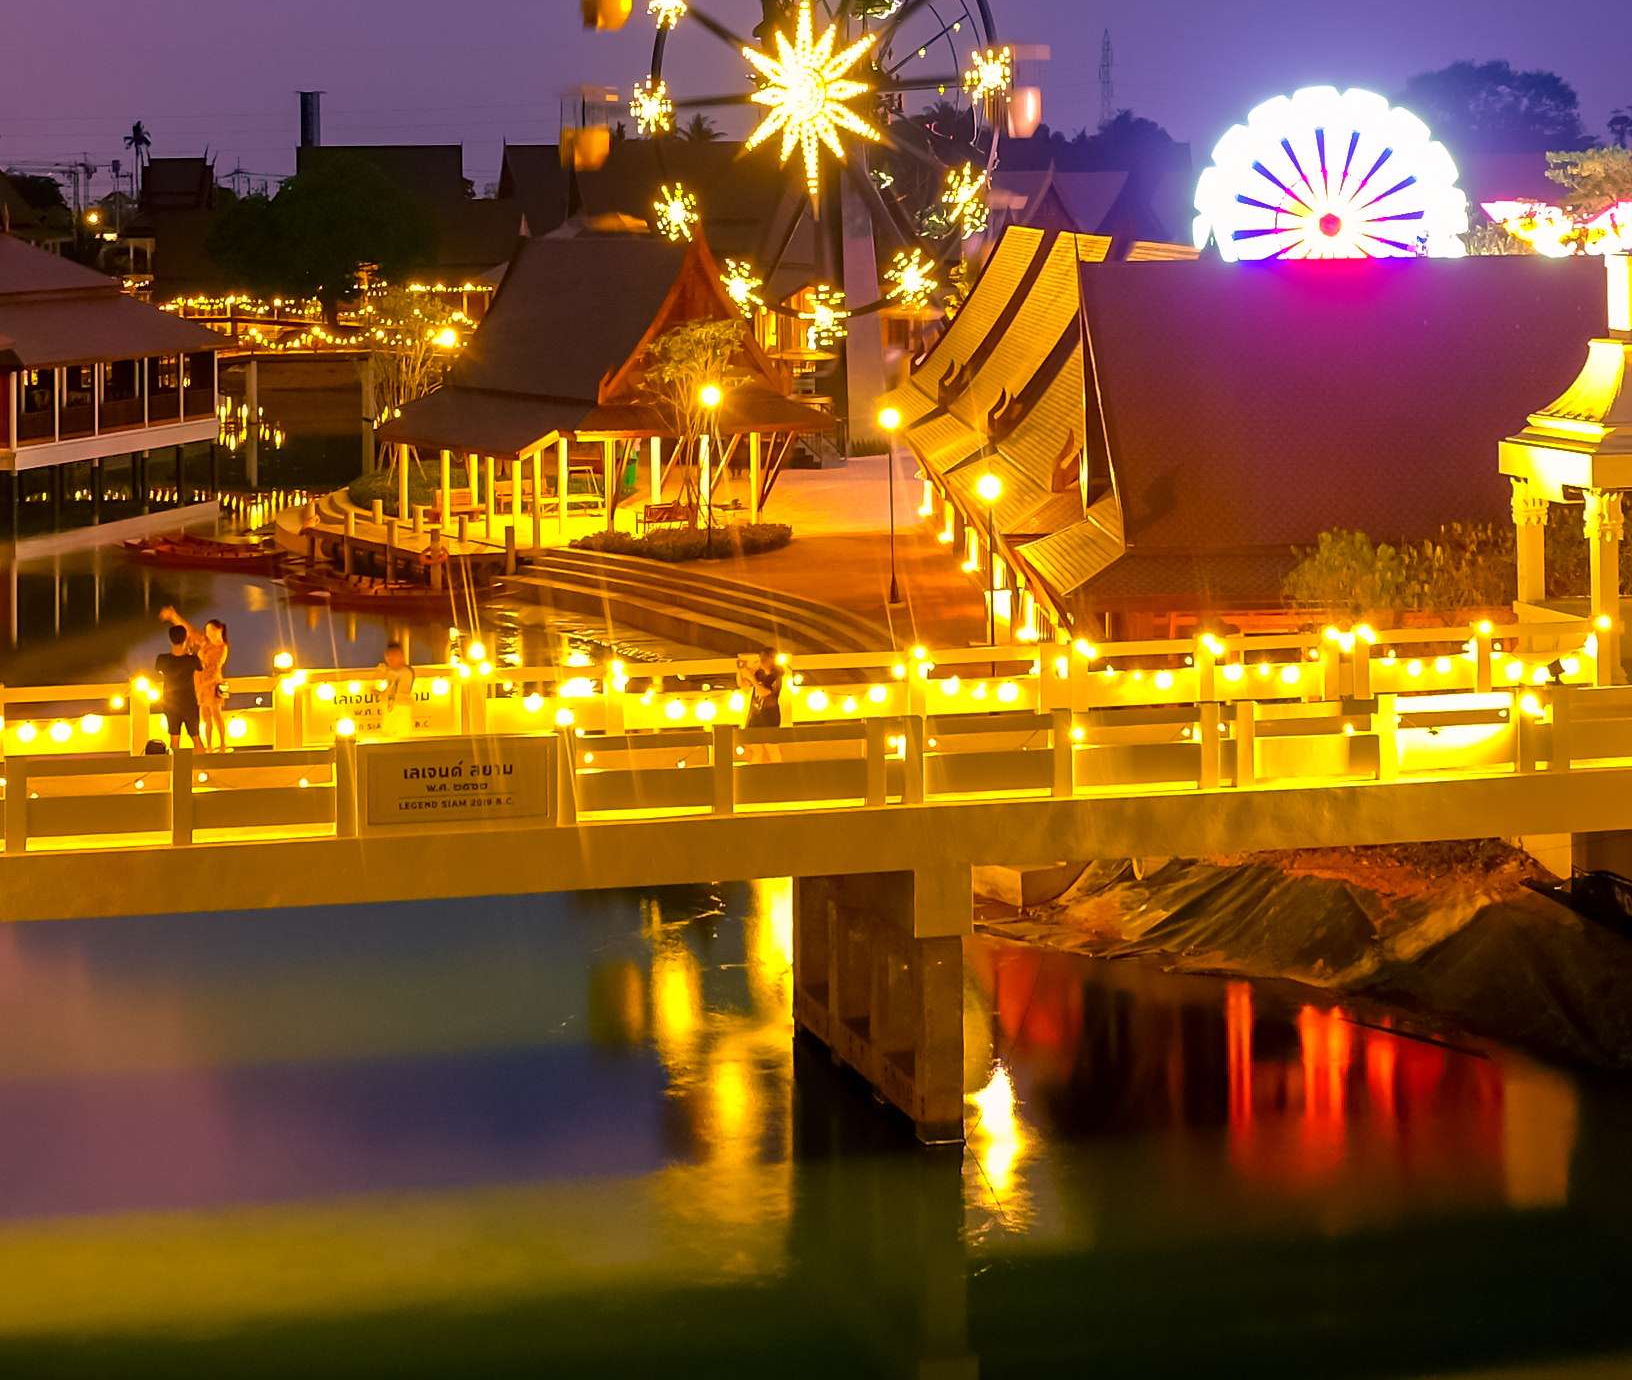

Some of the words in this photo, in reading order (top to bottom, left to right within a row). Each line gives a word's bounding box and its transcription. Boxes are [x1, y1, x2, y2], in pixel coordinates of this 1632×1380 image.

[470, 763, 513, 777] สยาม
[399, 800, 438, 811] LEGEND
[441, 799, 467, 808] SIAM
